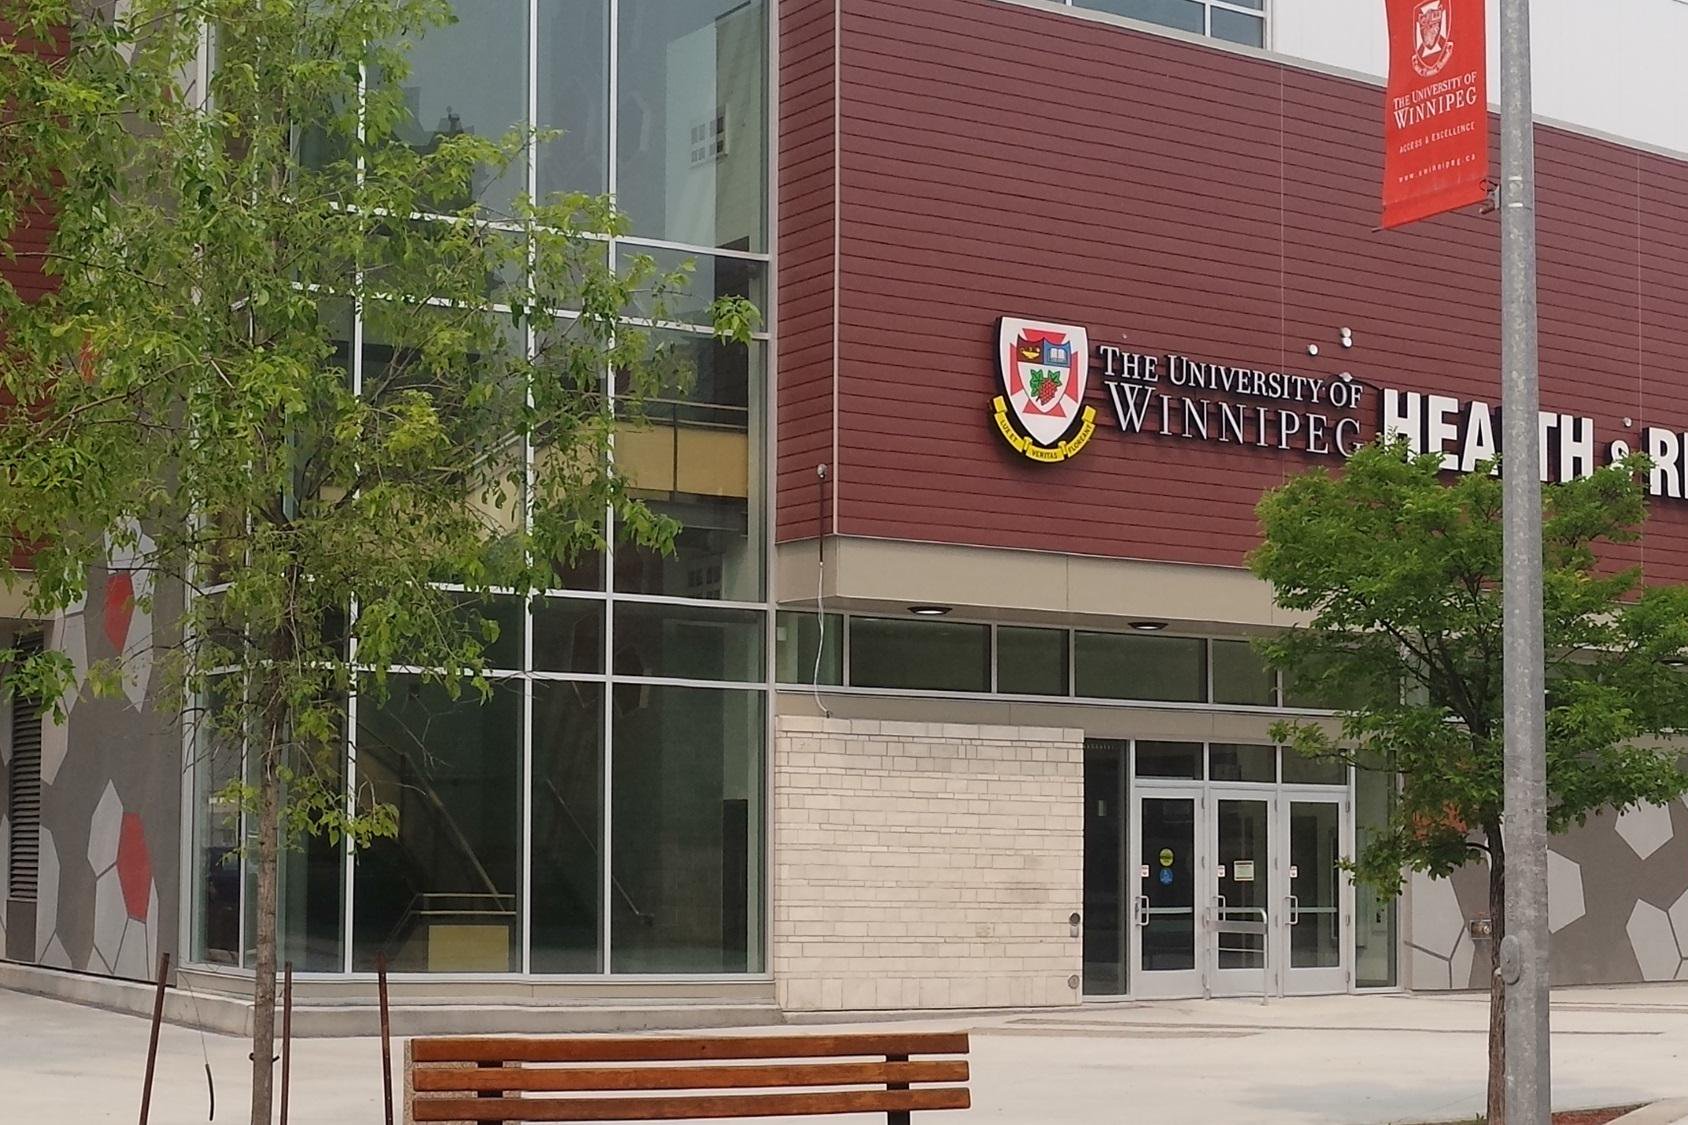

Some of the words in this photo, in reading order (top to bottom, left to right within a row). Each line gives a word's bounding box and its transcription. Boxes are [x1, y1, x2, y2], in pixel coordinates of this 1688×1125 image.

[1393, 95, 1411, 110] THE
[1412, 75, 1463, 103] UNIVERSITY
[1464, 71, 1477, 85] OF
[1394, 86, 1477, 129] WINNIPEG
[1399, 138, 1423, 154] ACCESS
[1431, 121, 1475, 142] EXCELLENCE
[1100, 345, 1158, 382] THE
[1168, 353, 1326, 404] UNIVERSITY
[1329, 381, 1363, 409] OF
[1104, 380, 1365, 458] WINNIPEG
[1384, 387, 1594, 484] HEATH
